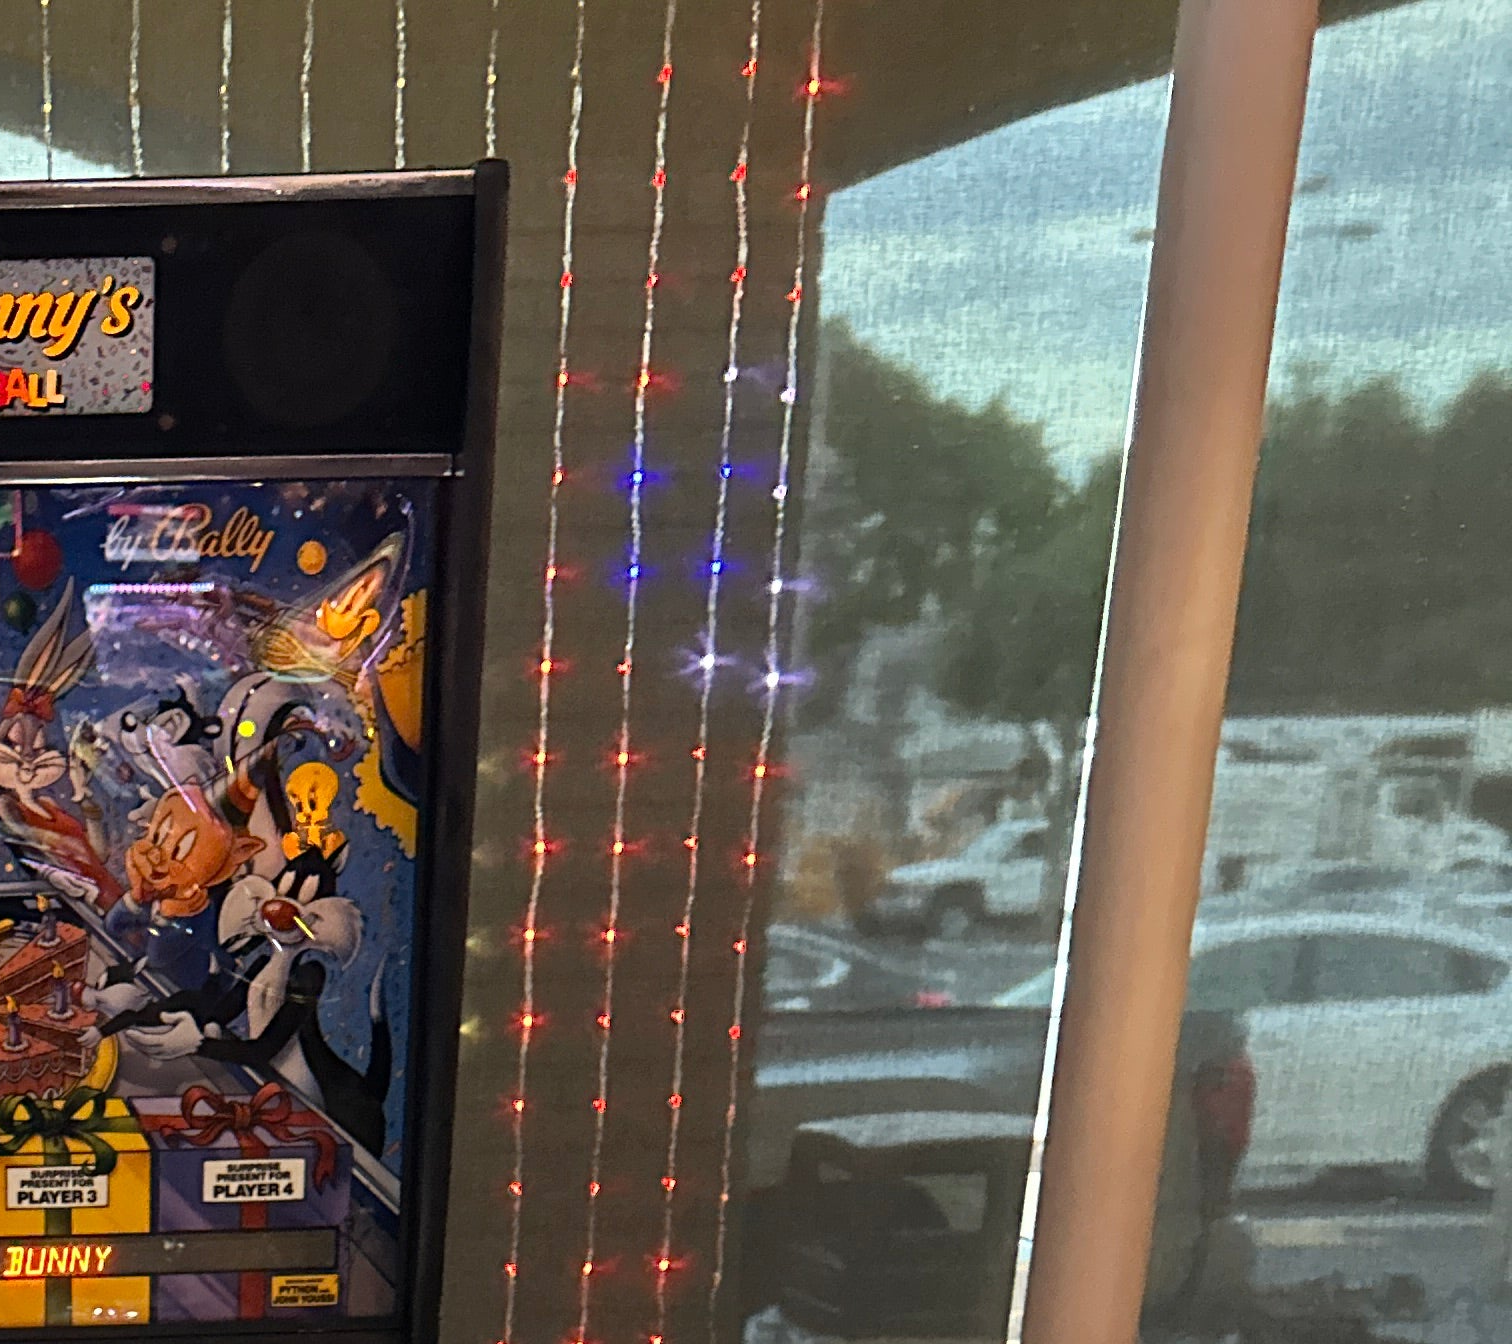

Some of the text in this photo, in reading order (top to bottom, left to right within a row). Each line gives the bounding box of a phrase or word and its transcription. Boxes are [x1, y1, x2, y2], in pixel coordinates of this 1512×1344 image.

[99, 502, 275, 573] by Bally
[30, 1169, 86, 1180] SURPRISE
[226, 1162, 281, 1173] SURPRISE
[216, 1170, 291, 1182] PRESENT FOR
[19, 1178, 94, 1189] PRESENT FOR
[17, 1189, 97, 1205] PLAYER 3
[213, 1183, 294, 1199] PLAYER 4
[2, 1245, 112, 1278] BUNNY
